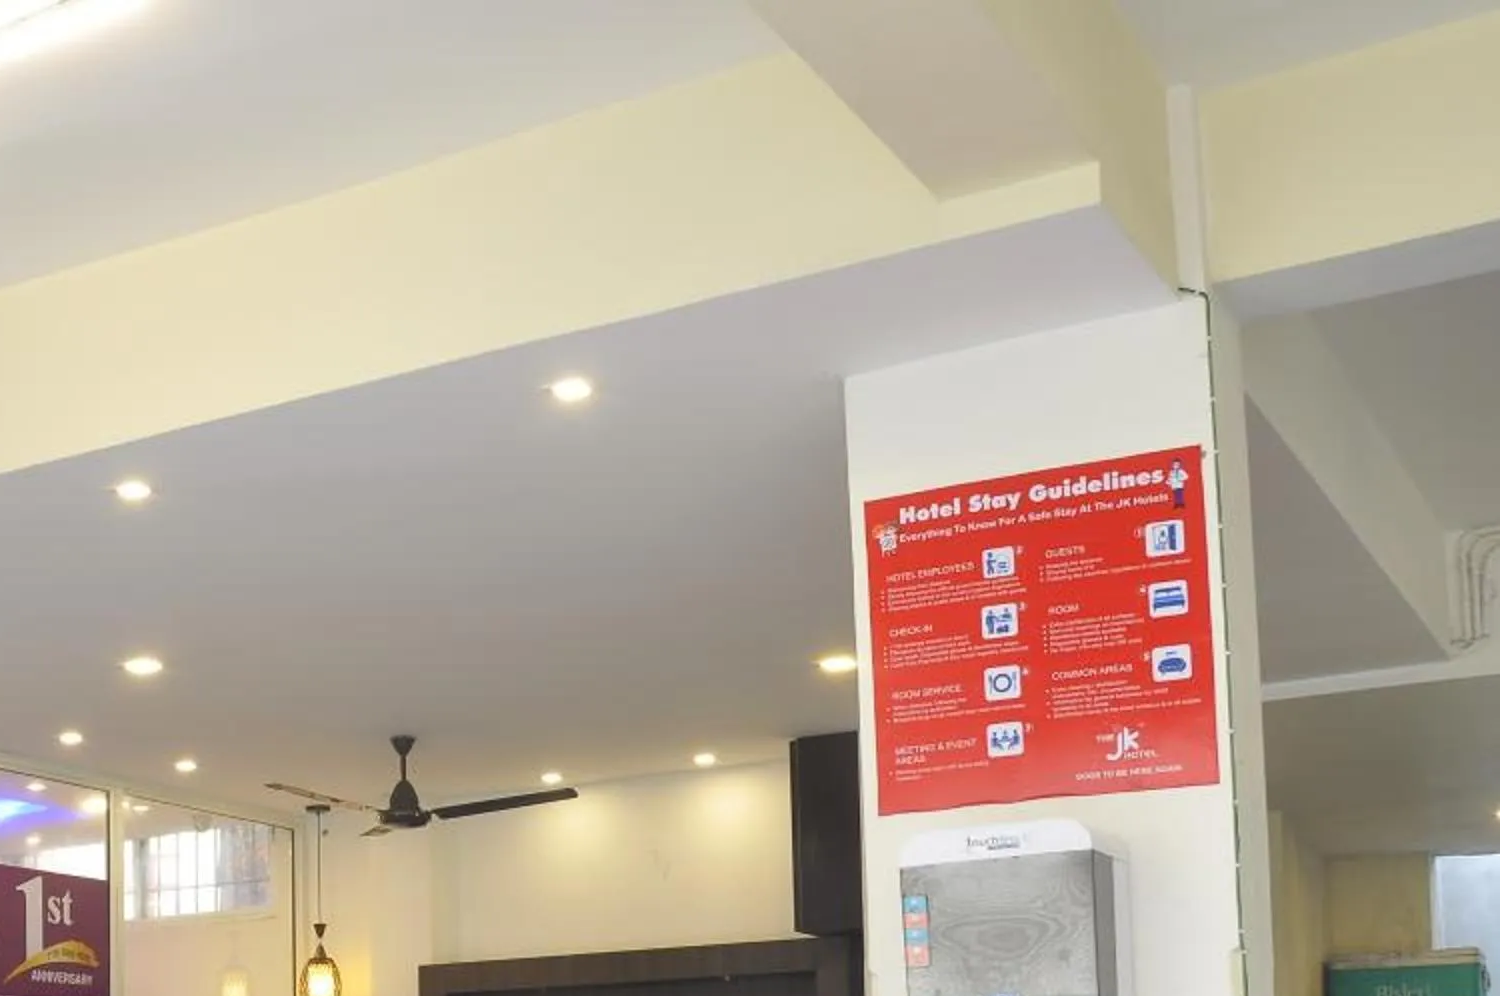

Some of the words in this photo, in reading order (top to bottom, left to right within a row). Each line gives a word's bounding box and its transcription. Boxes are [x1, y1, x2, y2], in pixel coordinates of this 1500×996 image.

[900, 498, 960, 524] Hotel
[968, 492, 1021, 512] Stay
[1029, 469, 1164, 502] Guidelines
[900, 526, 952, 543] Everything
[955, 524, 966, 534] To
[968, 519, 996, 531] Know
[999, 517, 1015, 526] For
[1018, 514, 1026, 523] A
[1028, 508, 1052, 521] Safe
[1054, 505, 1076, 518] Stay
[1079, 503, 1092, 513] At
[1095, 499, 1114, 510] The
[1116, 496, 1131, 509] JK
[886, 571, 916, 582] HOTEL
[31, 968, 93, 986] ANNIVERSARY
